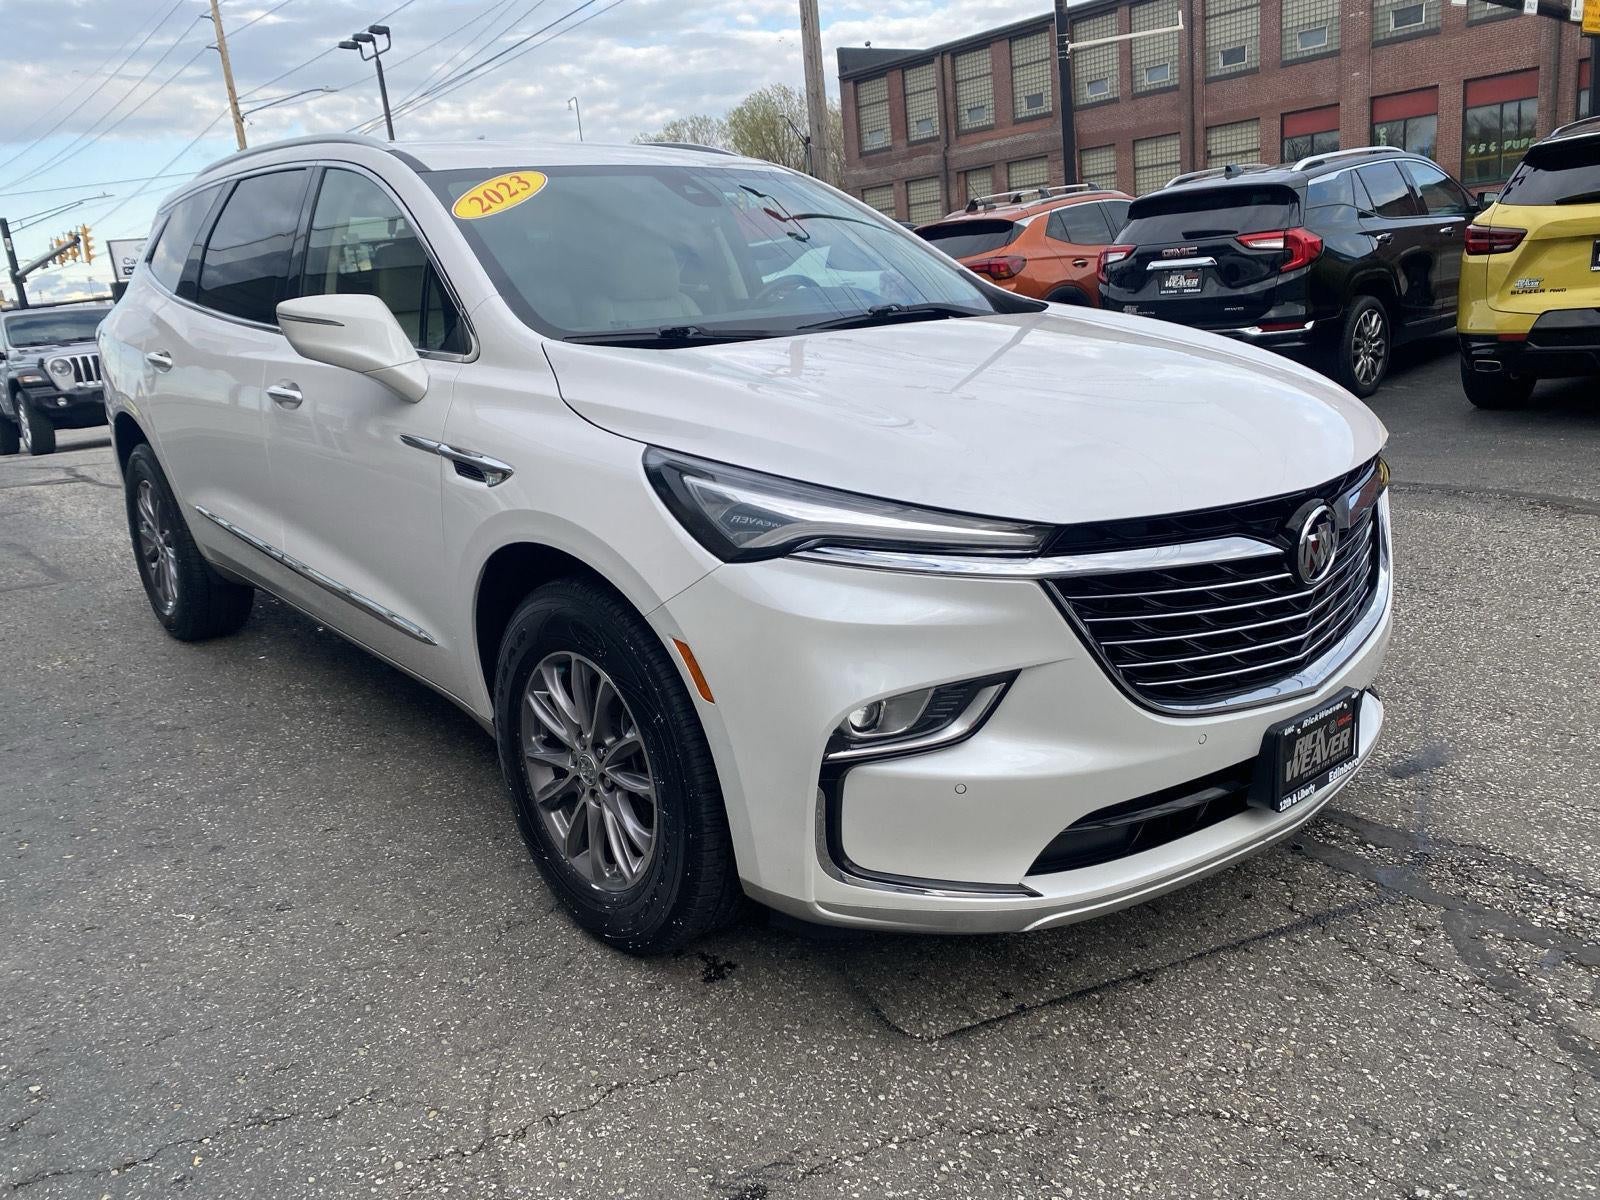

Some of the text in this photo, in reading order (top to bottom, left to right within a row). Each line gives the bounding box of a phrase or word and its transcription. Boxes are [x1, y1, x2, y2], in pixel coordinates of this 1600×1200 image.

[468, 175, 531, 213] 2023
[1162, 246, 1197, 257] GMC
[1286, 728, 1351, 782] WEAVER
[1294, 724, 1328, 756] RICK
[1328, 757, 1360, 783] Edinboro
